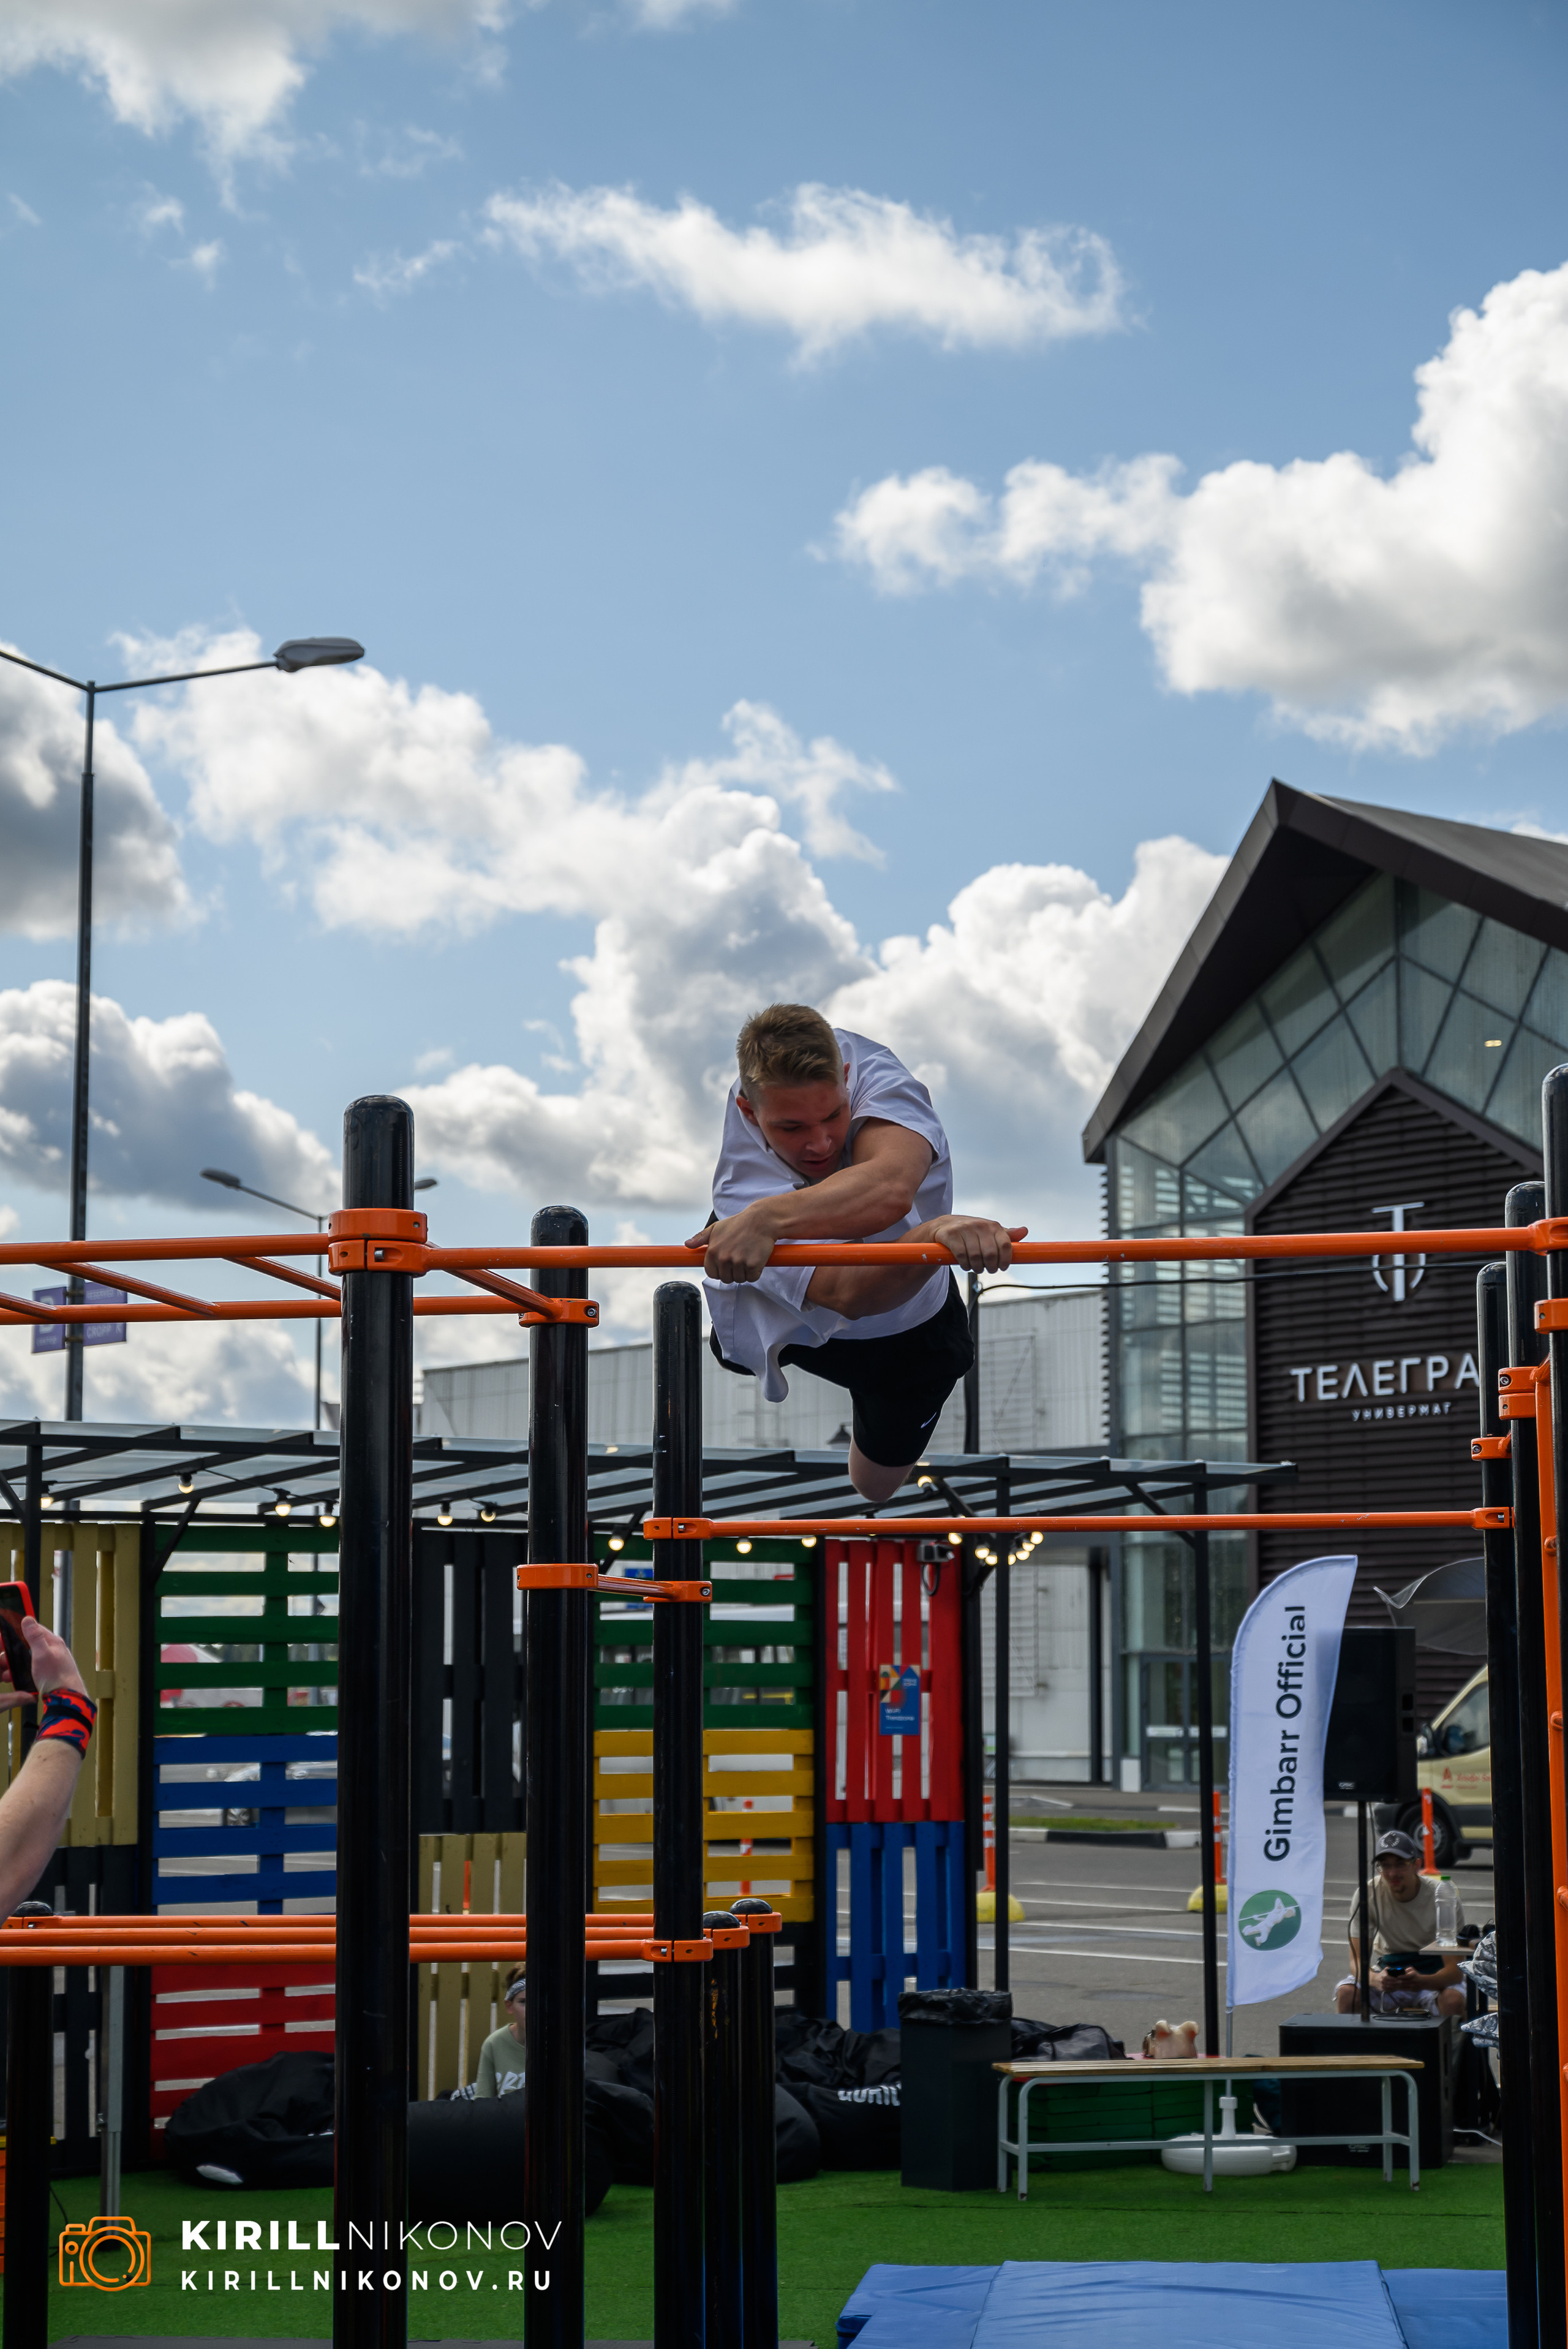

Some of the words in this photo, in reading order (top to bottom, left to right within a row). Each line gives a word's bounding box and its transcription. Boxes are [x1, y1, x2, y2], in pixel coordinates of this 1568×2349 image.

[1289, 1353, 1480, 1402] ТЕЛЕГРА
[1351, 1402, 1452, 1421] УНИВЕРМАГ
[1276, 1606, 1306, 1719] Official
[1263, 1730, 1300, 1862] Gimbarr
